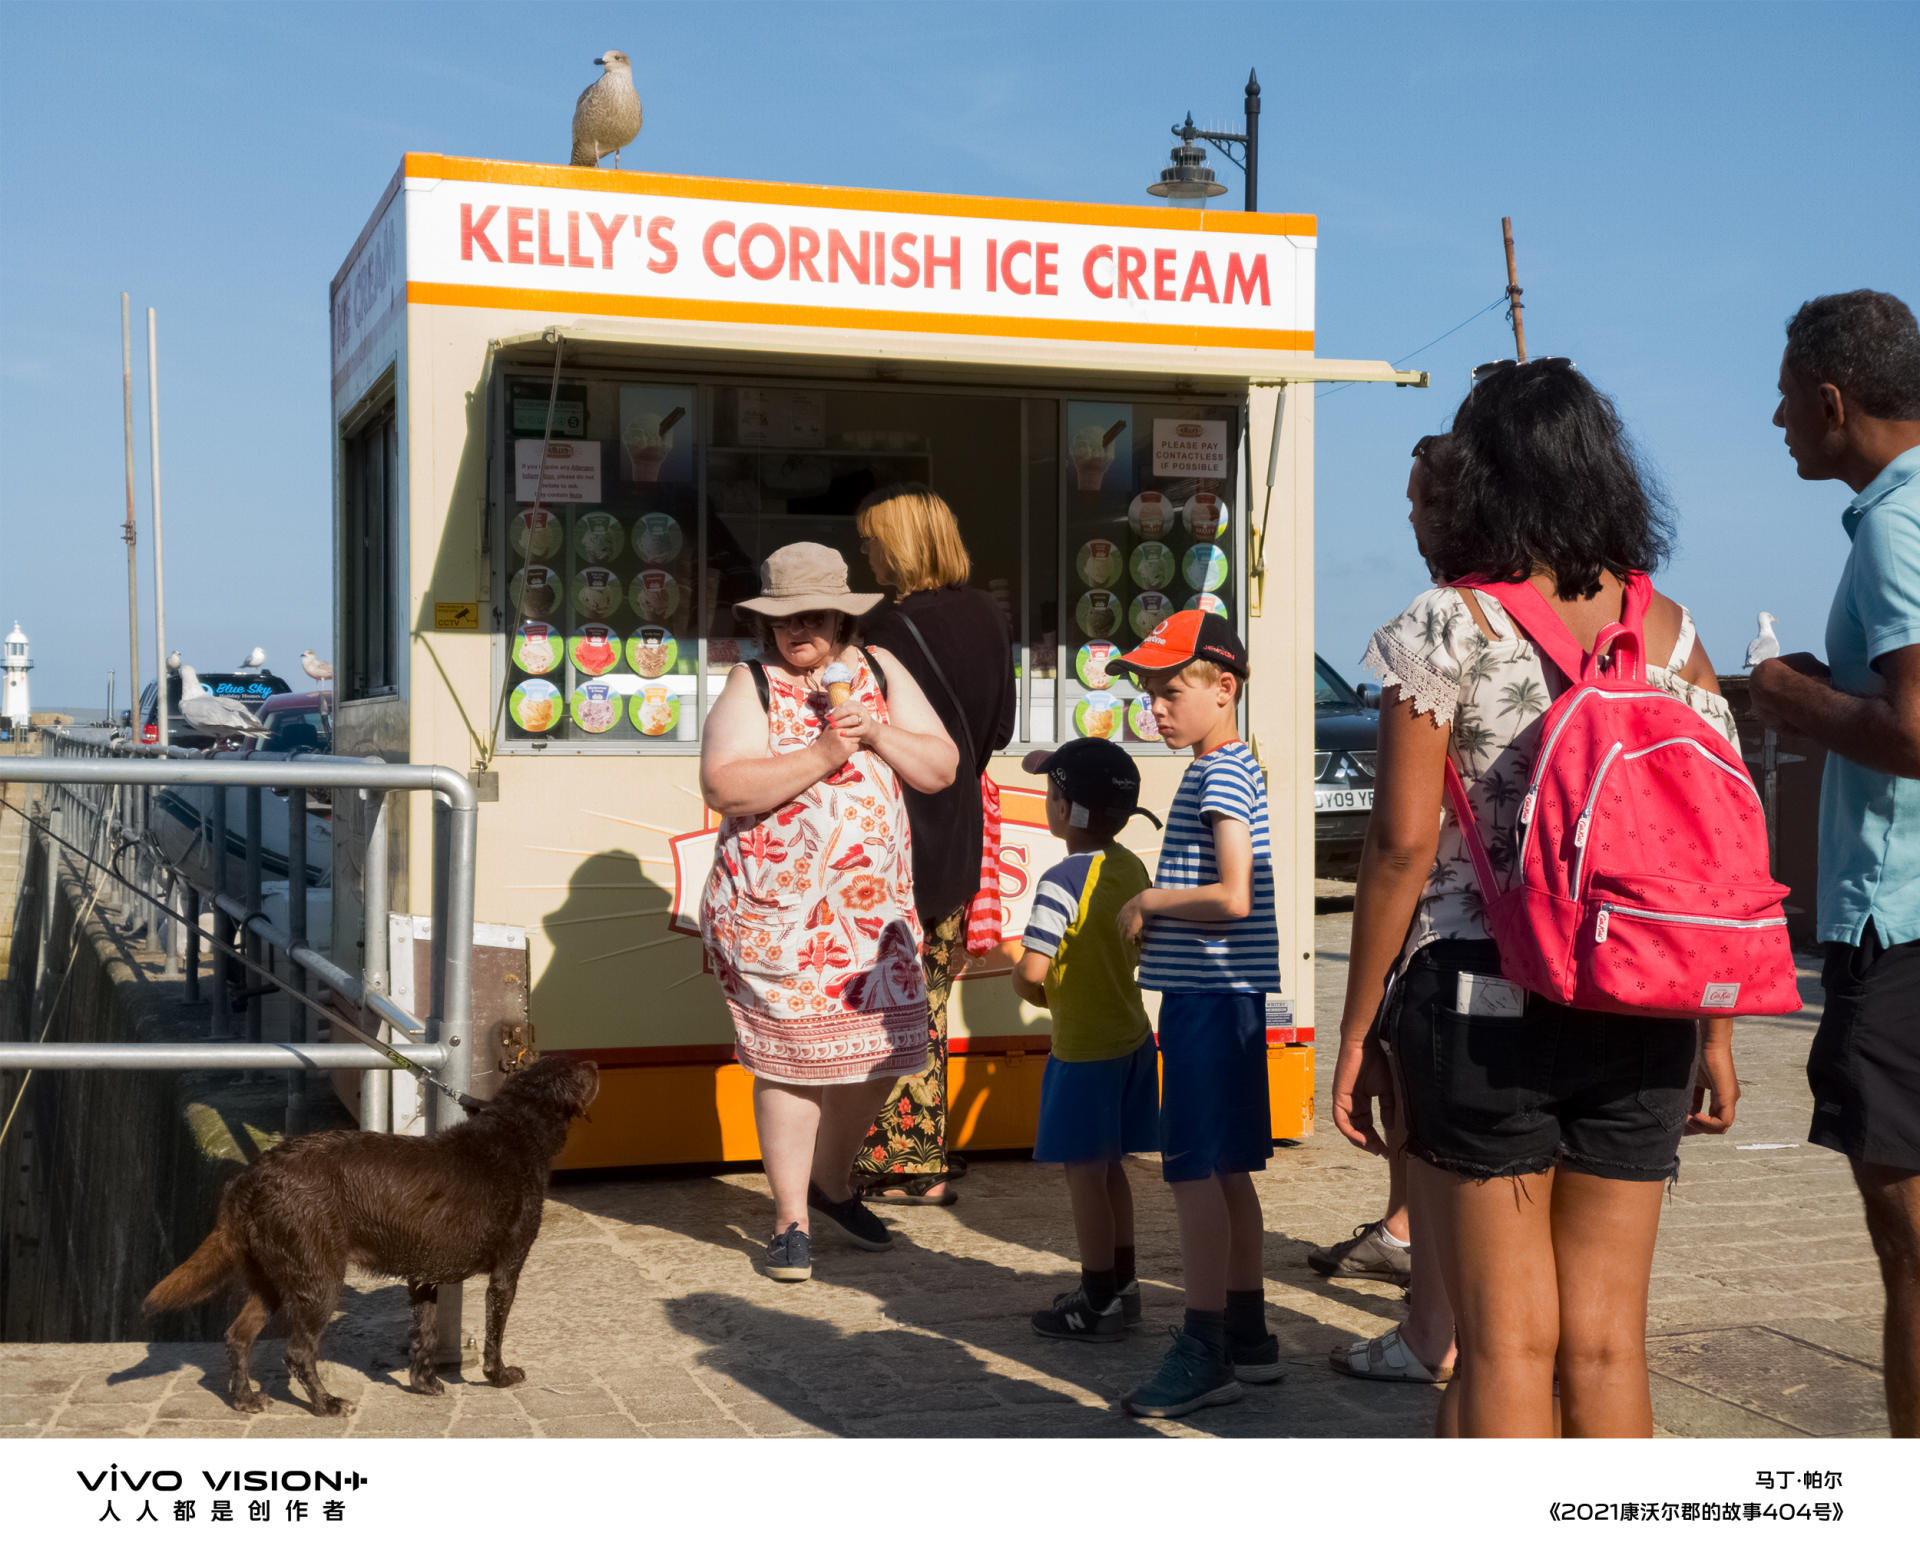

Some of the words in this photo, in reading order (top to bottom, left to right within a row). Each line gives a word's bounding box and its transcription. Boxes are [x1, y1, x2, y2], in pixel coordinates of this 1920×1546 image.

[460, 203, 678, 275] KELLY'S
[702, 220, 961, 290] CORNISH
[987, 240, 1058, 296] ICE
[1083, 245, 1270, 306] CREAM
[1161, 440, 1198, 450] PLEASE
[1201, 442, 1218, 450] PAY
[1156, 451, 1224, 461] CONTACTLESS
[1160, 462, 1169, 470] IF
[1172, 462, 1219, 472] POSSIBLE
[216, 683, 245, 694] Blue
[247, 683, 273, 699] Sky
